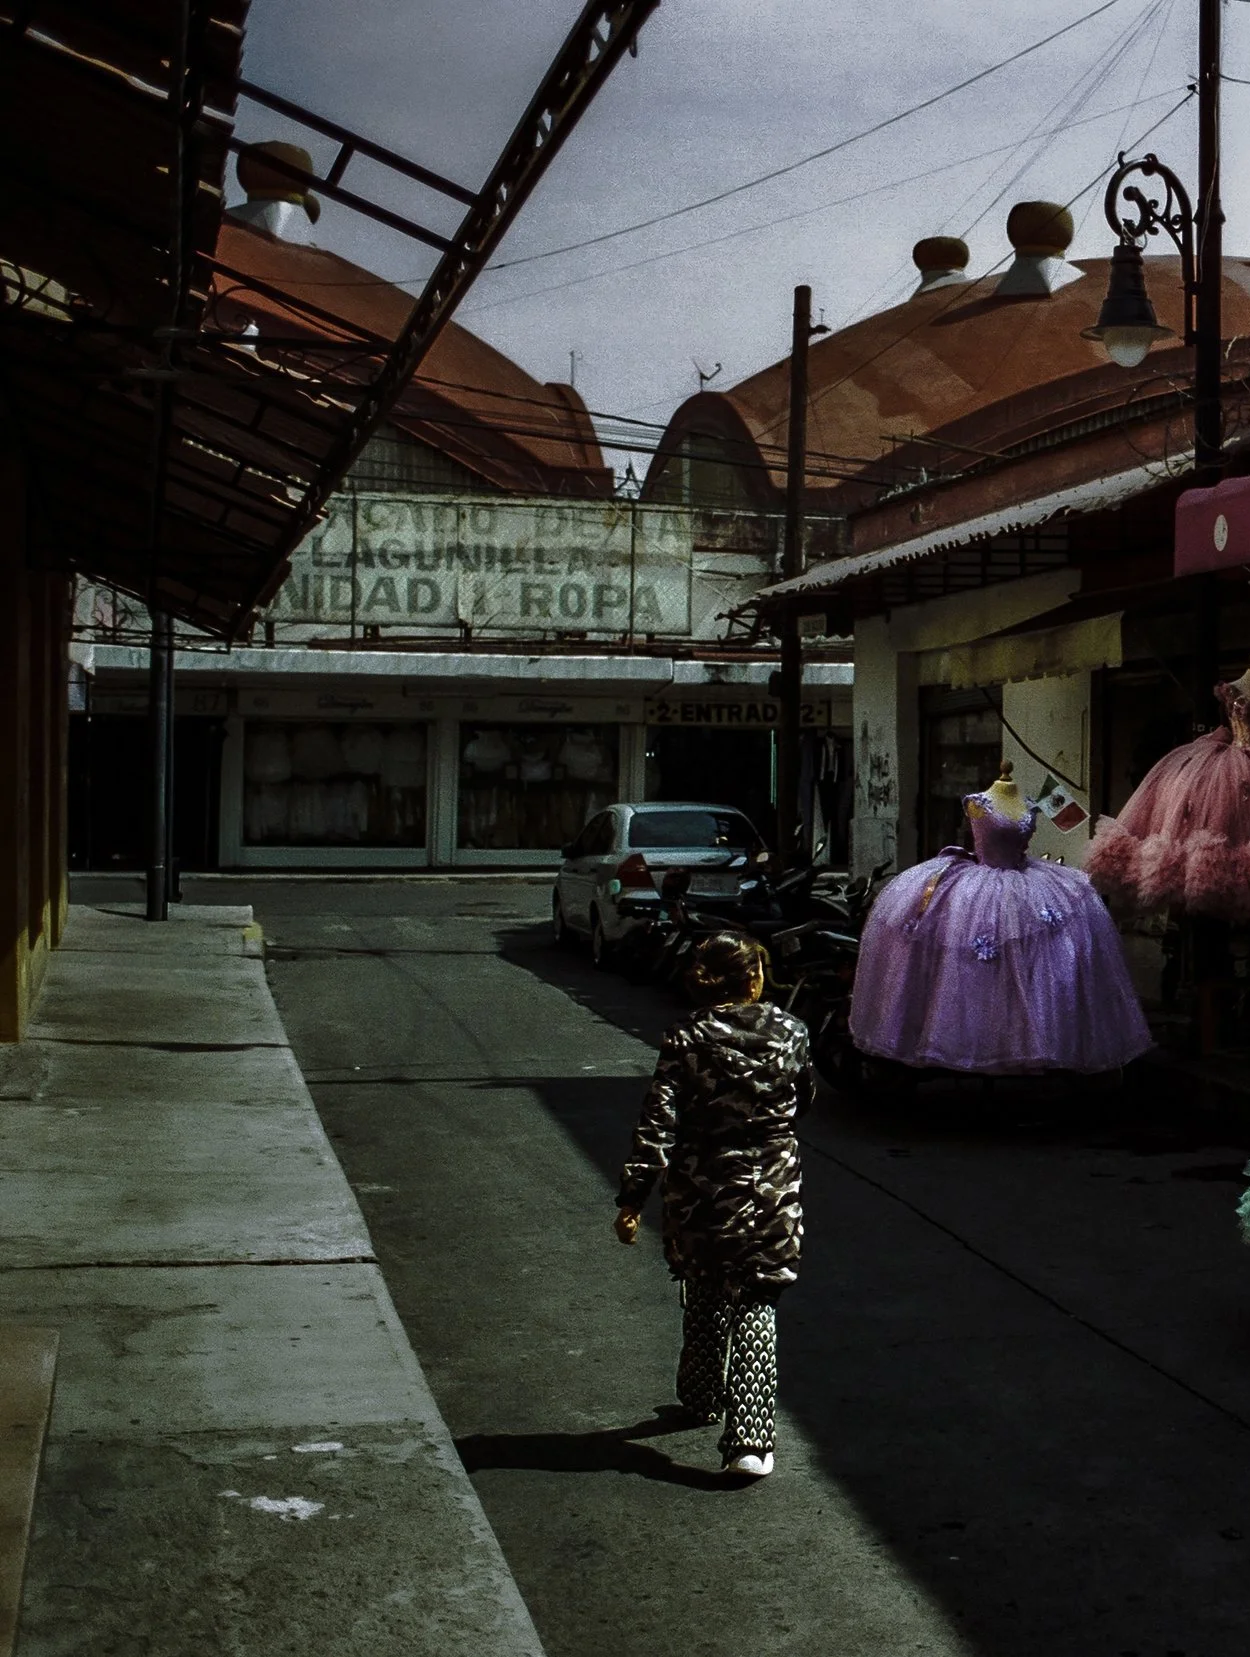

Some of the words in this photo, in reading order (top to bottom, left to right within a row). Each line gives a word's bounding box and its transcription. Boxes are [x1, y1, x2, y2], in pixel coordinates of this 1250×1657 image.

[311, 538, 593, 576] LAGUNILLA
[274, 573, 442, 616] NIDAD
[519, 581, 663, 622] ROPA
[681, 703, 779, 723] ENTRAD
